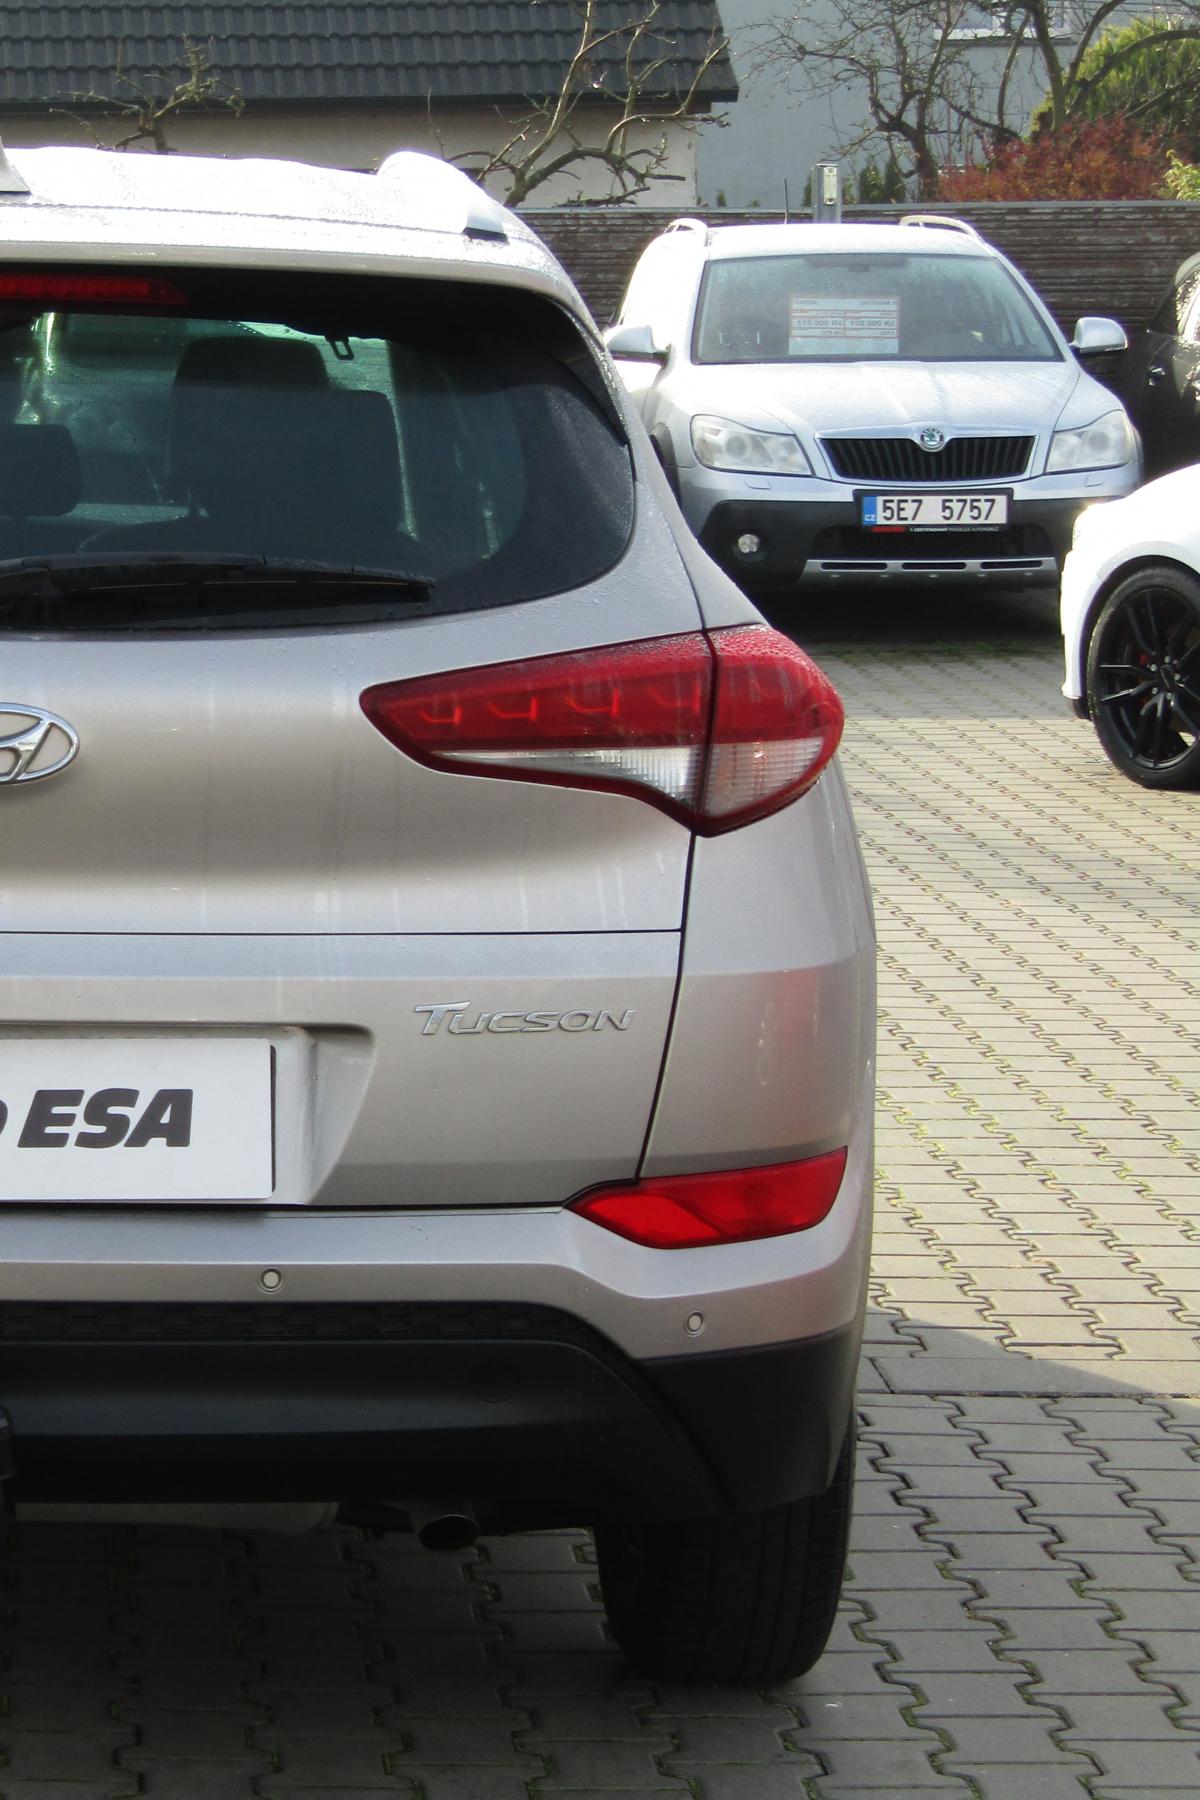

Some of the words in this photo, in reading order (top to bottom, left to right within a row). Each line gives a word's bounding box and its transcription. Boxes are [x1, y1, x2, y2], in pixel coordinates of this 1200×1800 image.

[883, 499, 923, 521] 5E7
[942, 499, 996, 521] 5757
[17, 1087, 194, 1149] ESA
